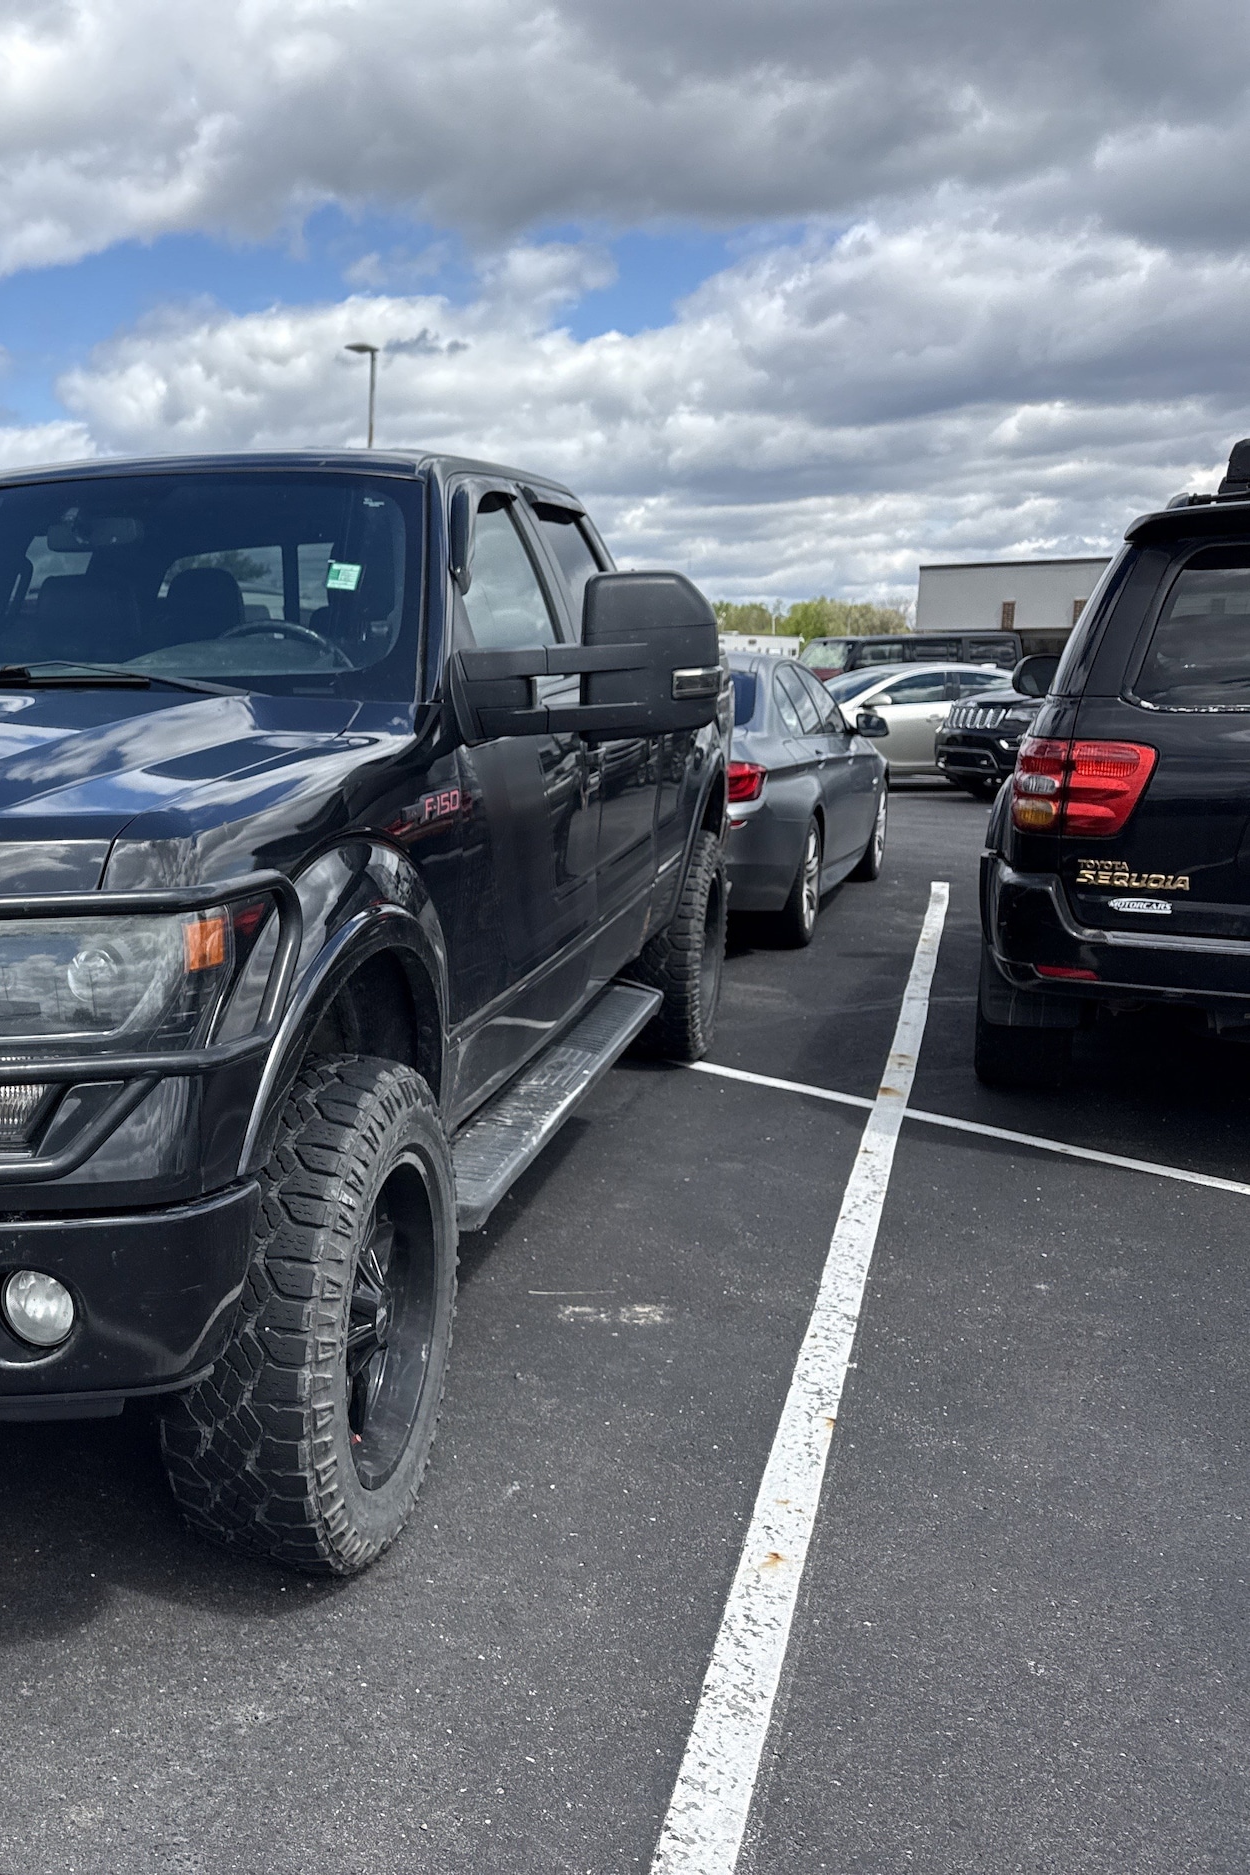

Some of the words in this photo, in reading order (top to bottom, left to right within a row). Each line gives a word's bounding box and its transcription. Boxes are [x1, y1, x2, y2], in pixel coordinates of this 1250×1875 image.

[424, 789, 460, 820] F-150
[1077, 858, 1130, 871] TOYOTA
[1075, 869, 1190, 891] SEQUOIA
[1107, 900, 1173, 911] MOTORCARS
